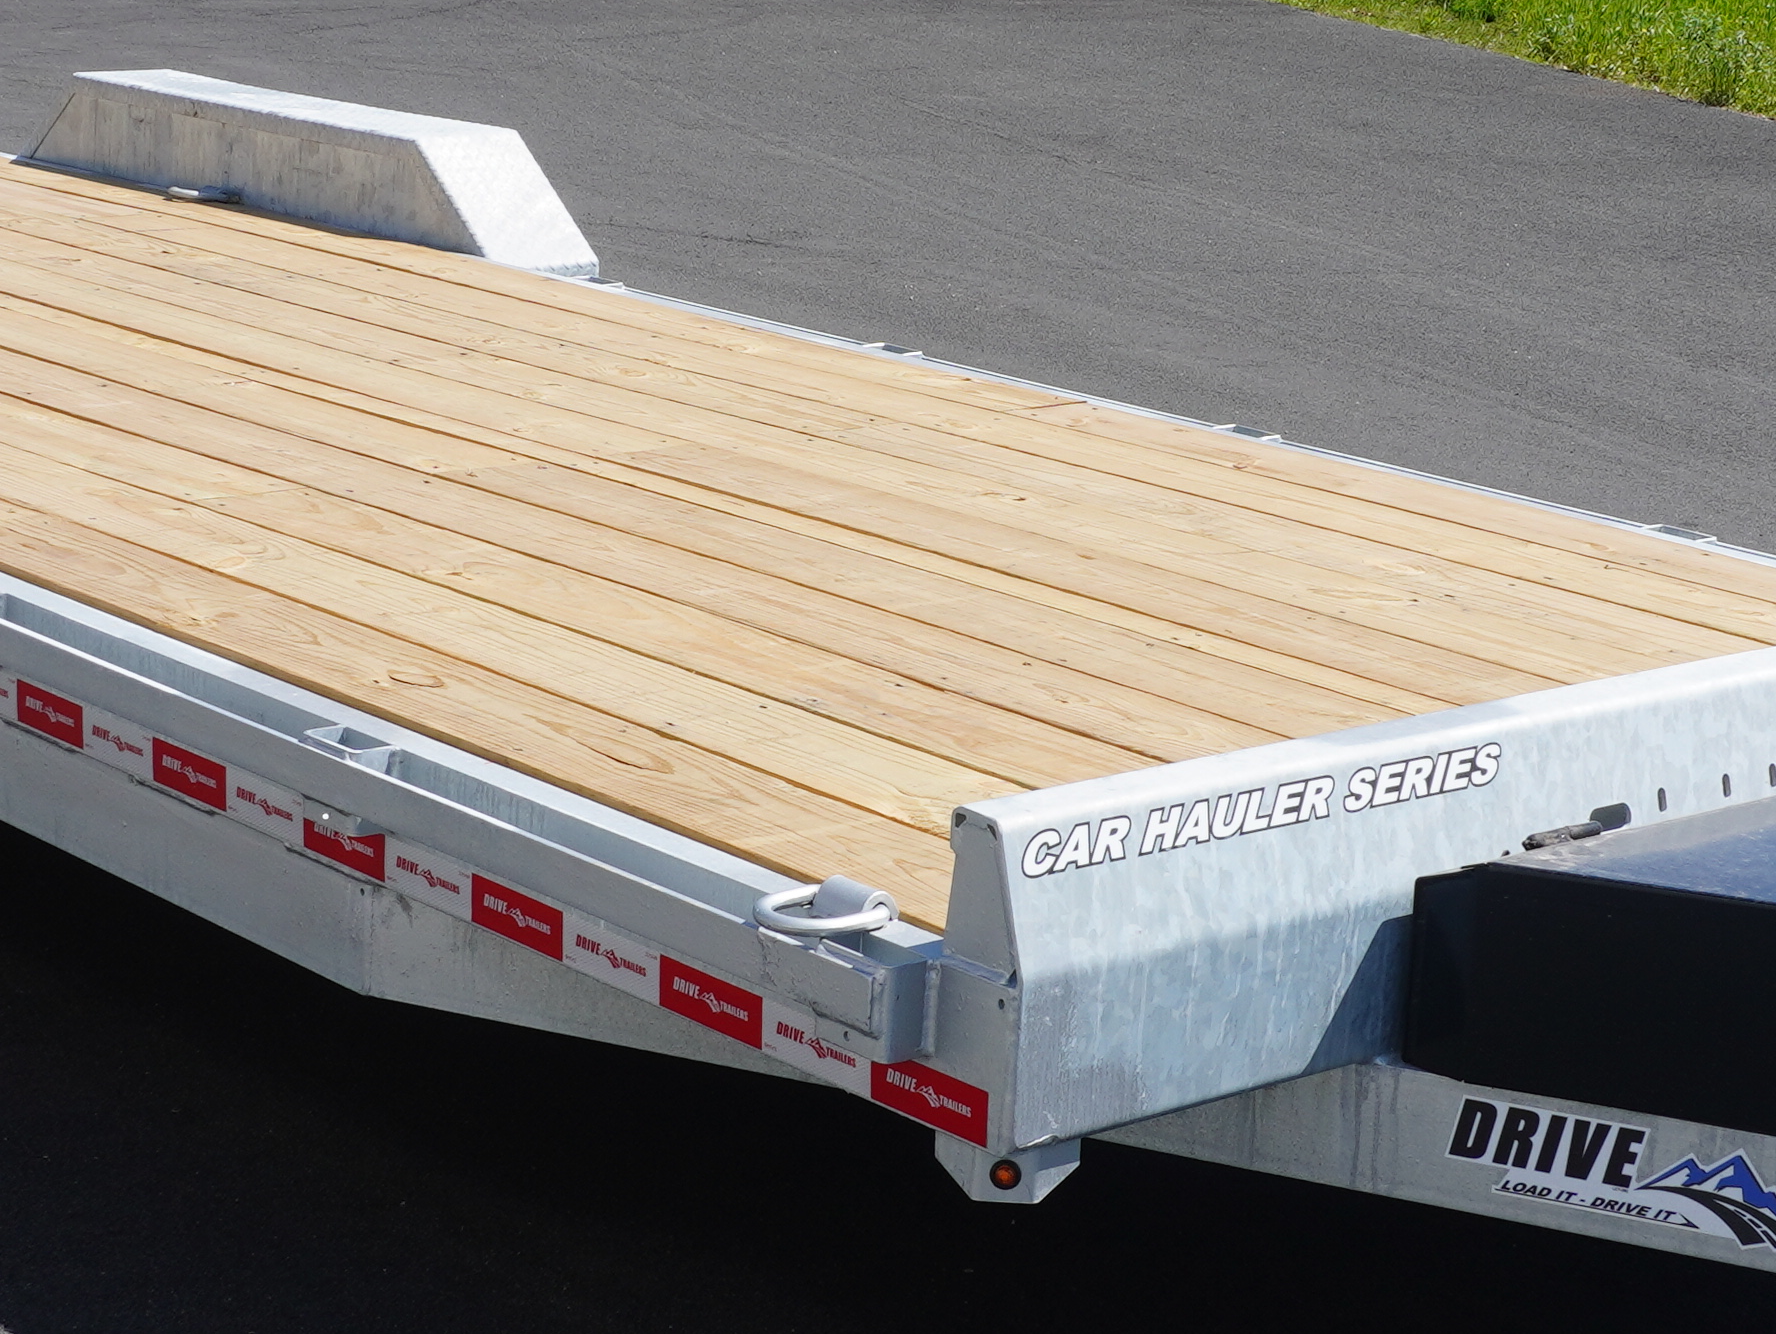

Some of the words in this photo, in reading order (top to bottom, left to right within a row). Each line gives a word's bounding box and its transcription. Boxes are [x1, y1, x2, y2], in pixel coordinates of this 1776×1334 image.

[1022, 813, 1132, 879] CAR
[1140, 775, 1334, 856] HAULER
[1343, 742, 1501, 812] SERIES
[396, 855, 419, 875] DRIVE
[483, 893, 508, 915] DRIVE
[576, 934, 601, 955] DRIVE
[620, 956, 646, 977] TRAILERS
[672, 976, 701, 1000] DRIVE
[719, 1000, 749, 1021] TRAILERS
[776, 1021, 805, 1044] DRIVE
[826, 1046, 857, 1068] TRAILERS
[886, 1067, 918, 1093] DRIVE
[939, 1094, 972, 1118] TRAILERS
[1448, 1098, 1645, 1189] DRIVE
[1500, 1179, 1552, 1197] LOAD
[1555, 1190, 1577, 1203] IT
[1590, 1196, 1651, 1217] DRIVE
[1653, 1209, 1676, 1221] IT
